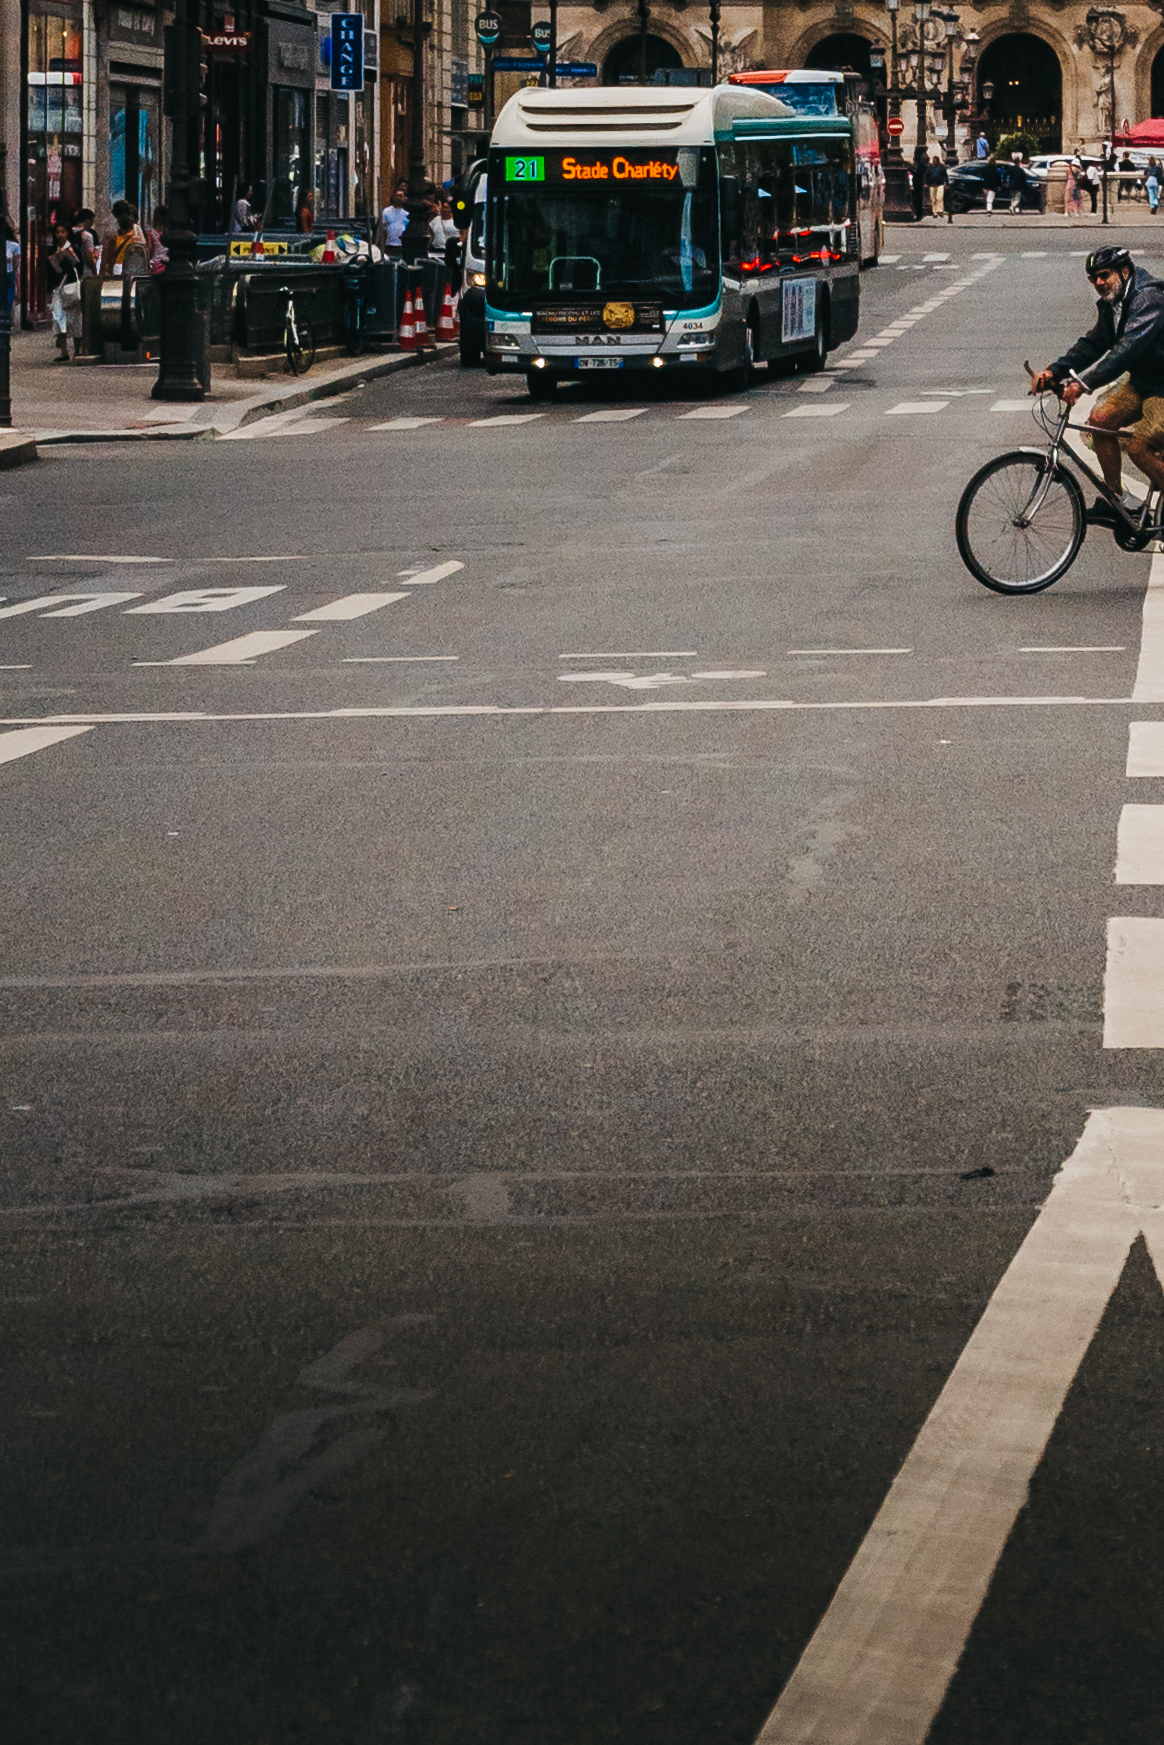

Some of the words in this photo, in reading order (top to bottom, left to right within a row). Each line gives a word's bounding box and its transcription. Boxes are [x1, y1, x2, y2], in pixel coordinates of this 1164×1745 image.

[478, 19, 499, 30] BUS
[340, 18, 355, 86] CHANGE
[515, 159, 537, 180] 21
[562, 157, 609, 180] Stade
[612, 156, 678, 181] Charléty
[682, 322, 703, 330] 4034
[574, 336, 621, 345] MAN
